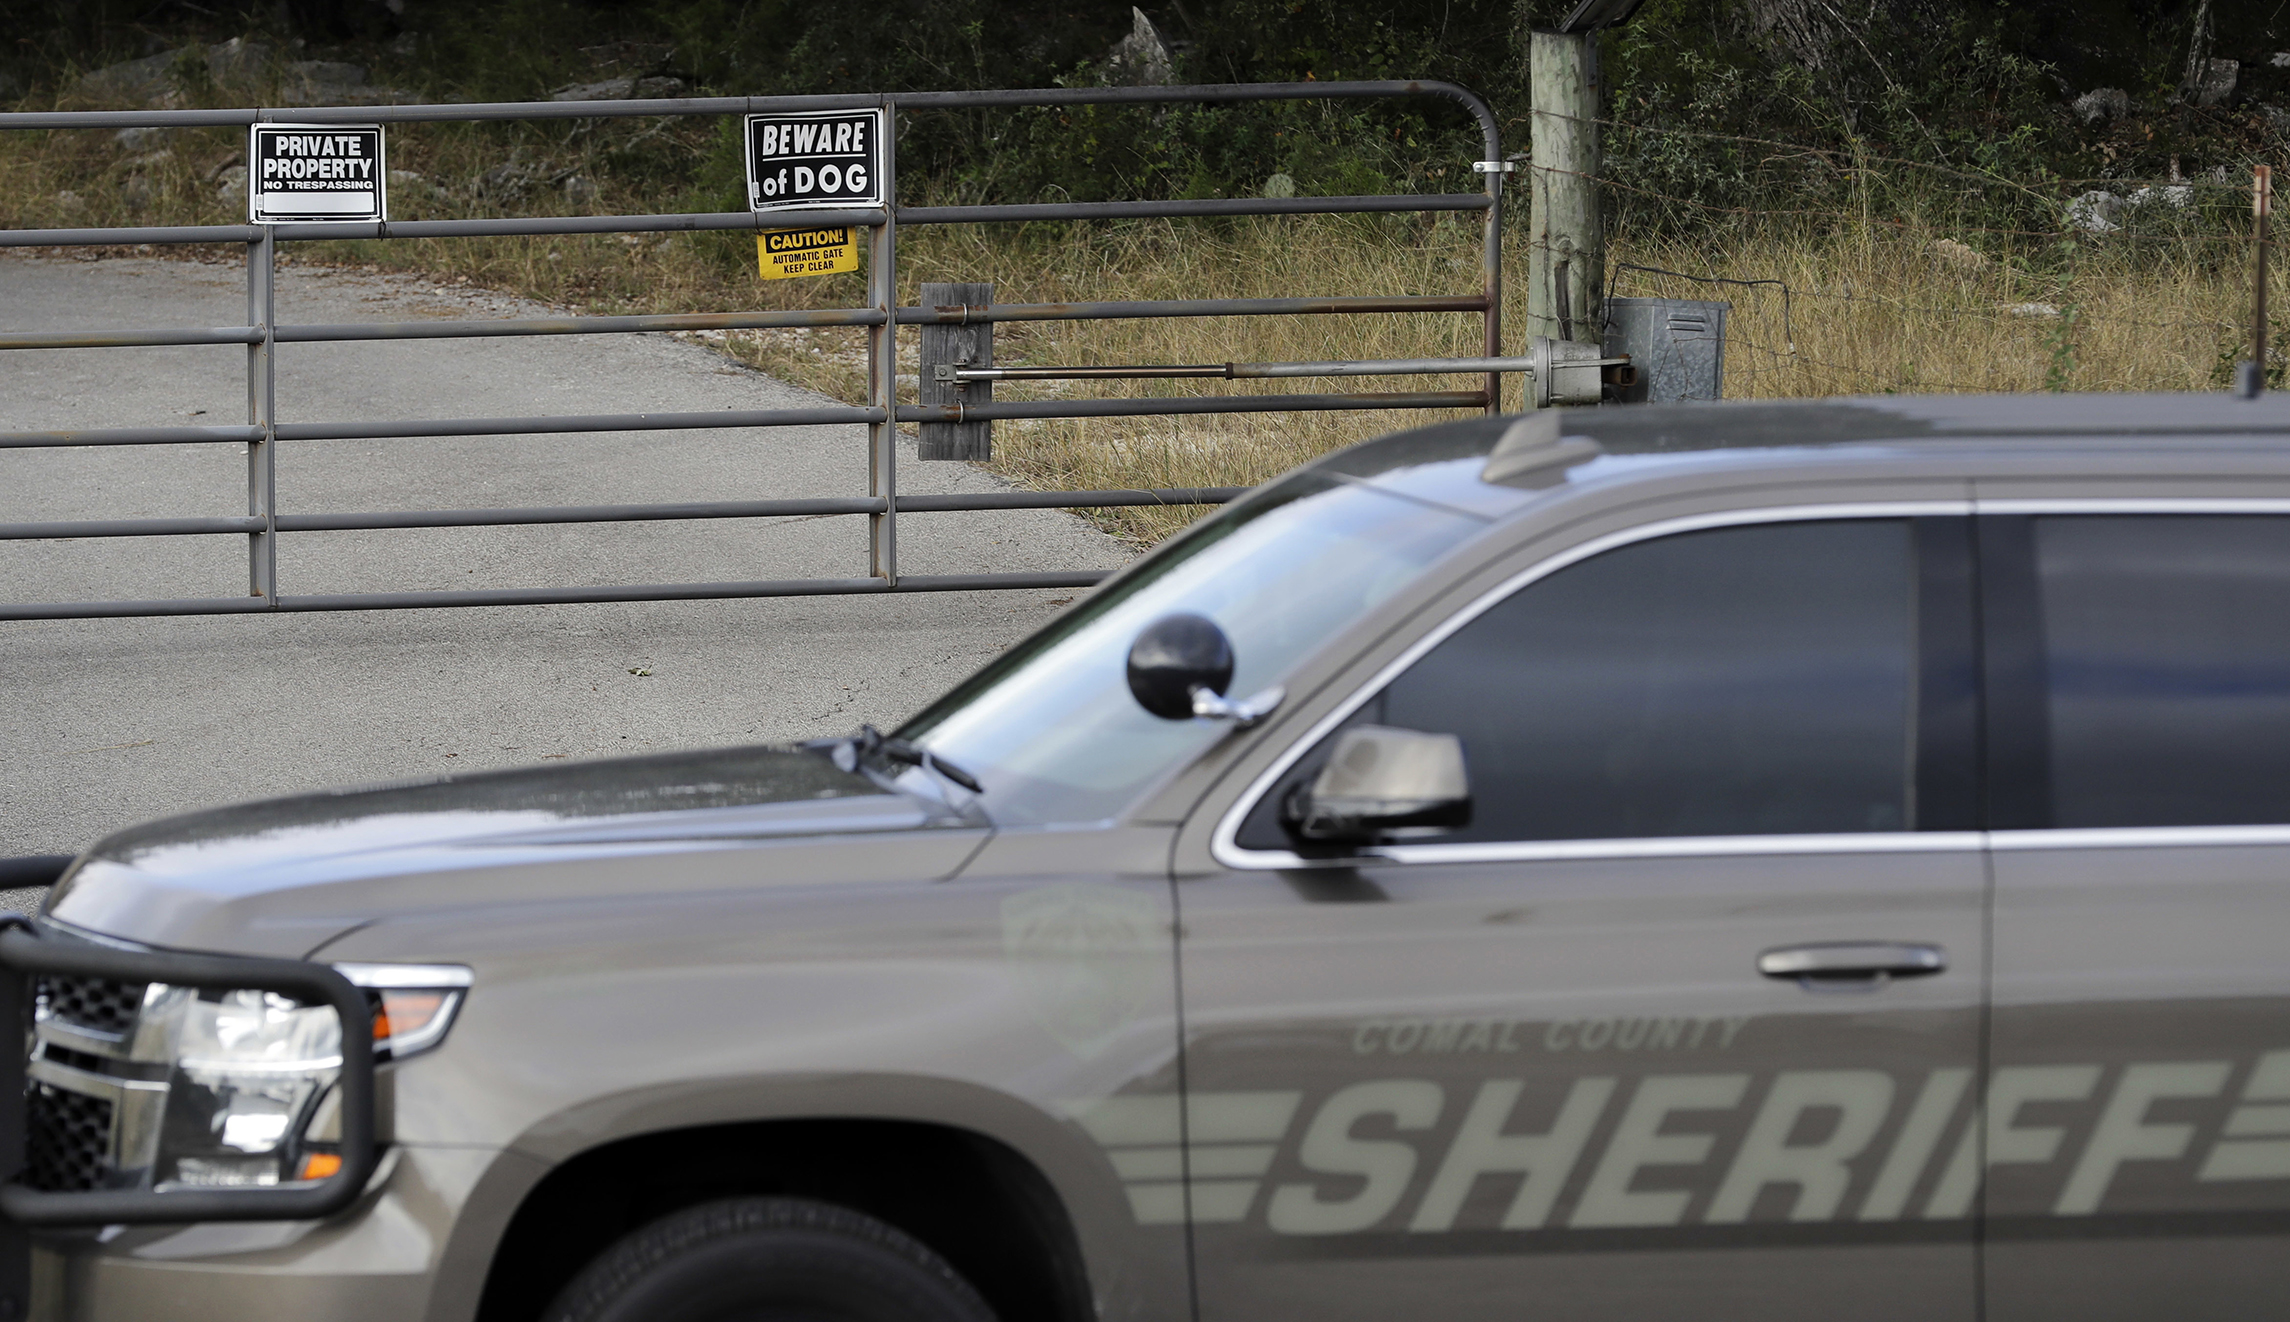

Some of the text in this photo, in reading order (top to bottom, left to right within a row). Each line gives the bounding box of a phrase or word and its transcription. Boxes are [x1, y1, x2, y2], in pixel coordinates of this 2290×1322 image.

[276, 136, 361, 156] PRIVATE
[762, 122, 865, 156] BEWARE
[263, 158, 372, 179] PROPERTY
[263, 181, 373, 190] NO TRESPASSING
[763, 164, 868, 196] of DOG
[770, 229, 843, 250] CAUTION!
[773, 248, 844, 265] AUTOMATIC GATE
[783, 260, 834, 274] KEEP CLEAR
[1352, 1014, 1750, 1055] COMAL COUNTY
[1266, 1061, 2234, 1237] SHERIFF
